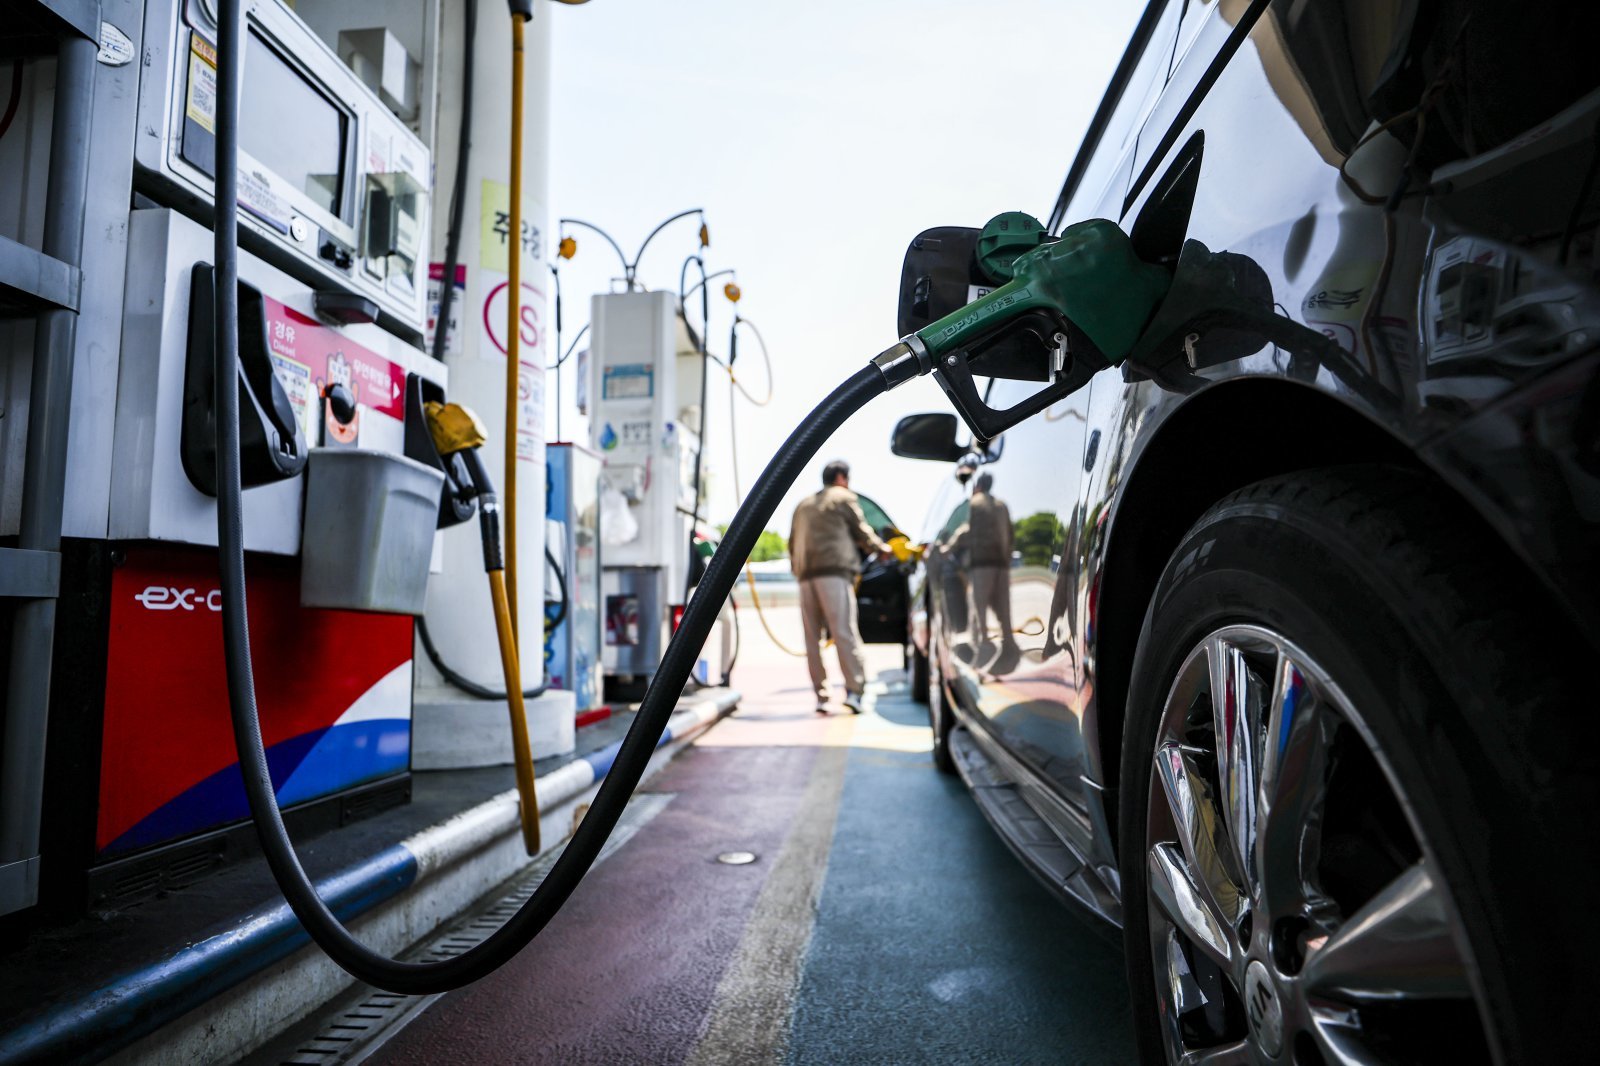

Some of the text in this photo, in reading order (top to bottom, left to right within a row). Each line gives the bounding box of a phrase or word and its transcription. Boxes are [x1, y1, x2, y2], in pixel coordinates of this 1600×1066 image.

[274, 320, 296, 344] 경유
[943, 312, 979, 337] OPW
[273, 338, 296, 358] Diesel
